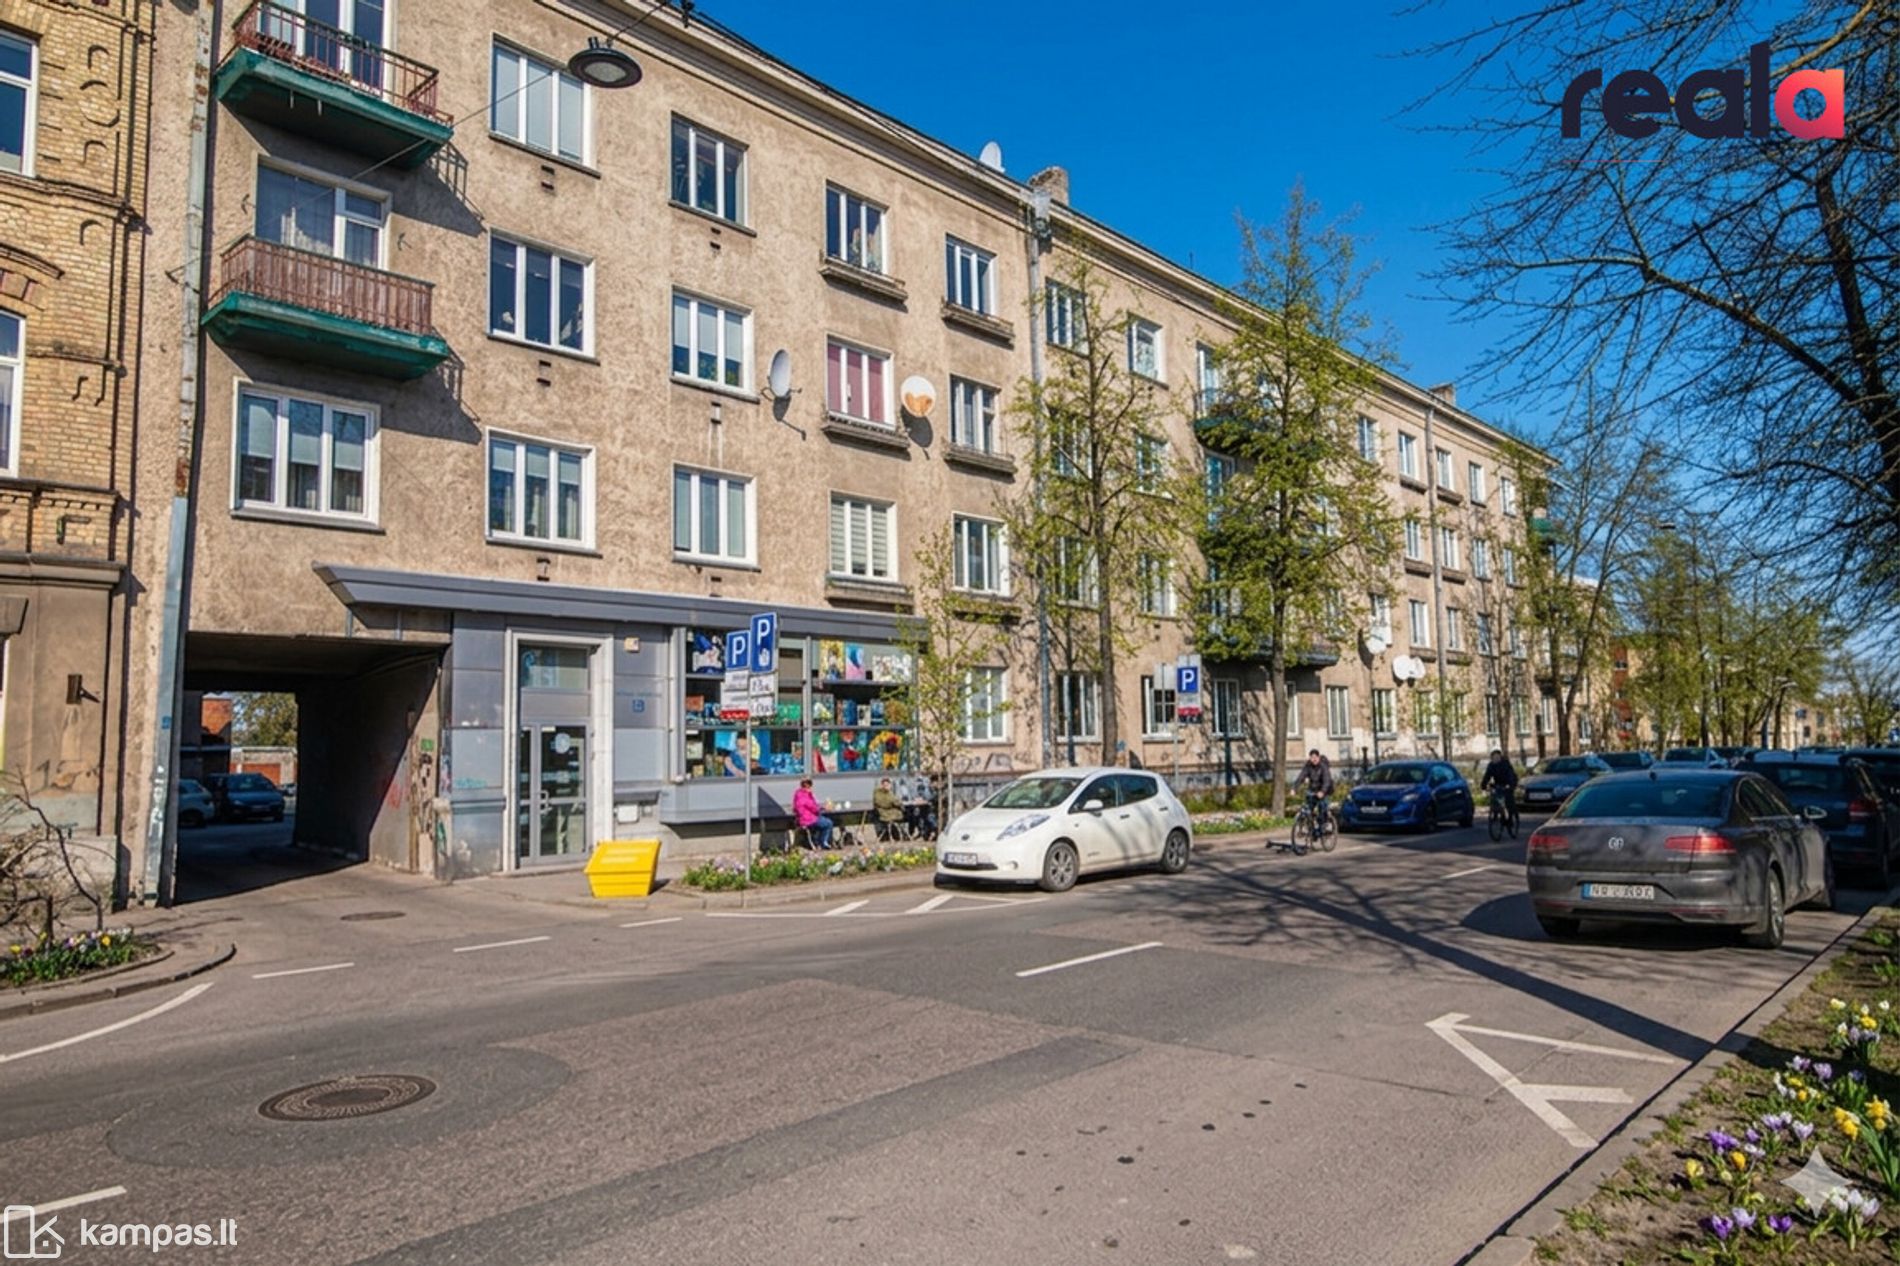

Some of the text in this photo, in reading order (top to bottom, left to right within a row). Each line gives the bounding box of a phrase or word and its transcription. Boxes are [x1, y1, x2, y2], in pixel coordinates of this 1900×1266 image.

[757, 619, 770, 646] P
[732, 636, 745, 665] P
[1181, 669, 1195, 691] P
